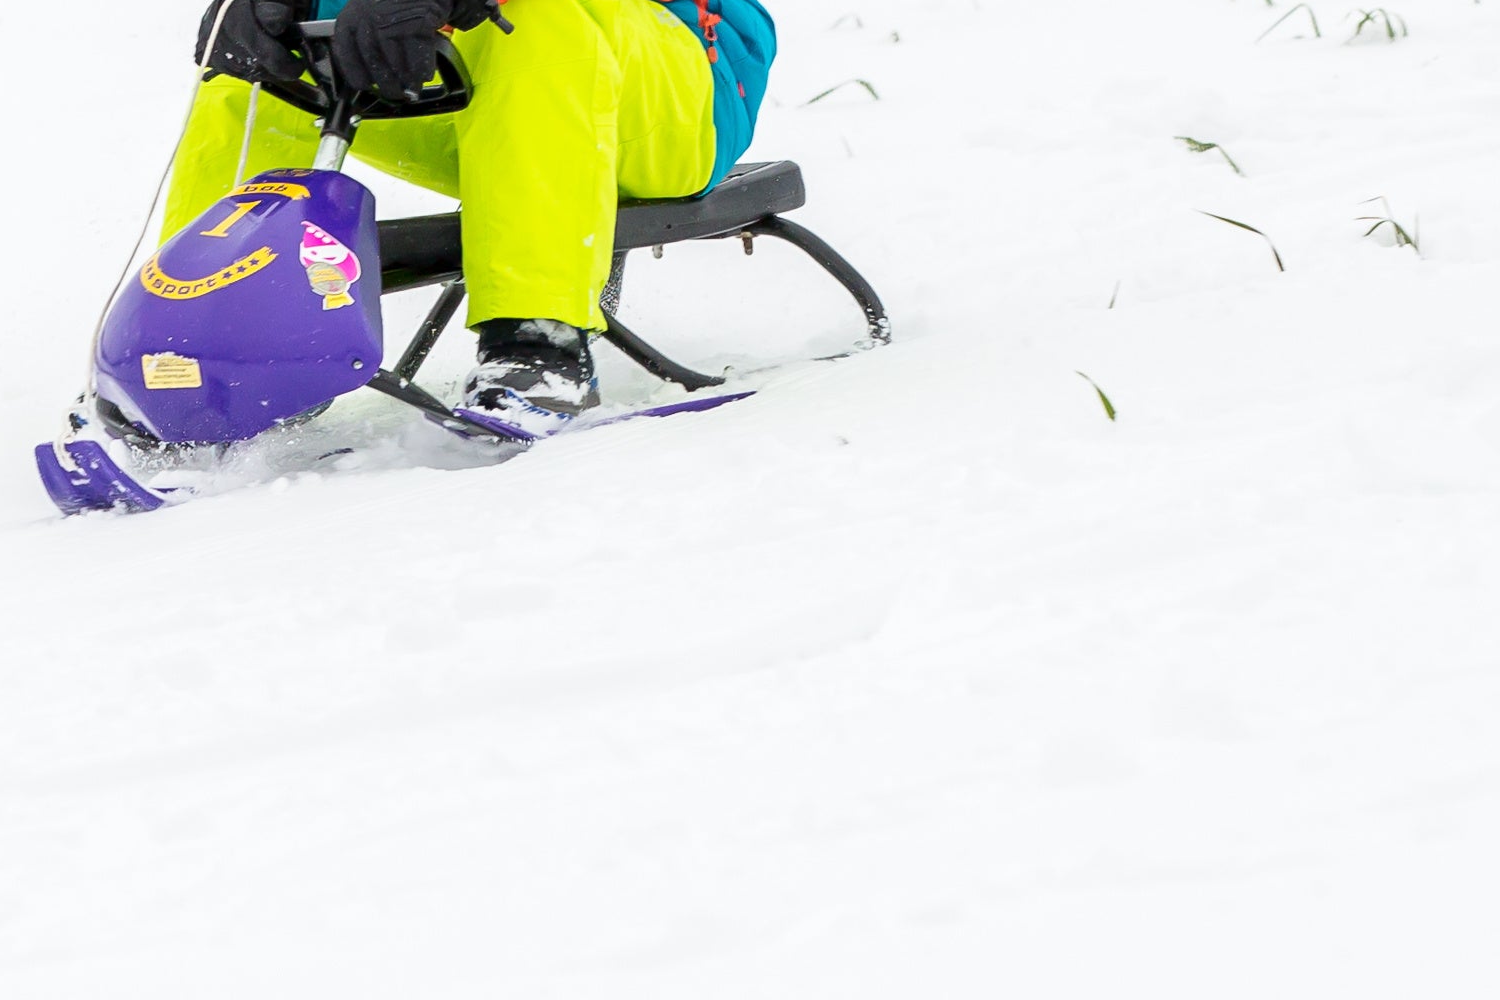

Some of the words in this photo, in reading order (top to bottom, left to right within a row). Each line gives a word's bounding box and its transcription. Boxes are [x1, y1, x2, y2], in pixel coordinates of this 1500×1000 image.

[243, 184, 288, 193] bob
[199, 199, 262, 238] 1
[151, 278, 217, 295] sport
